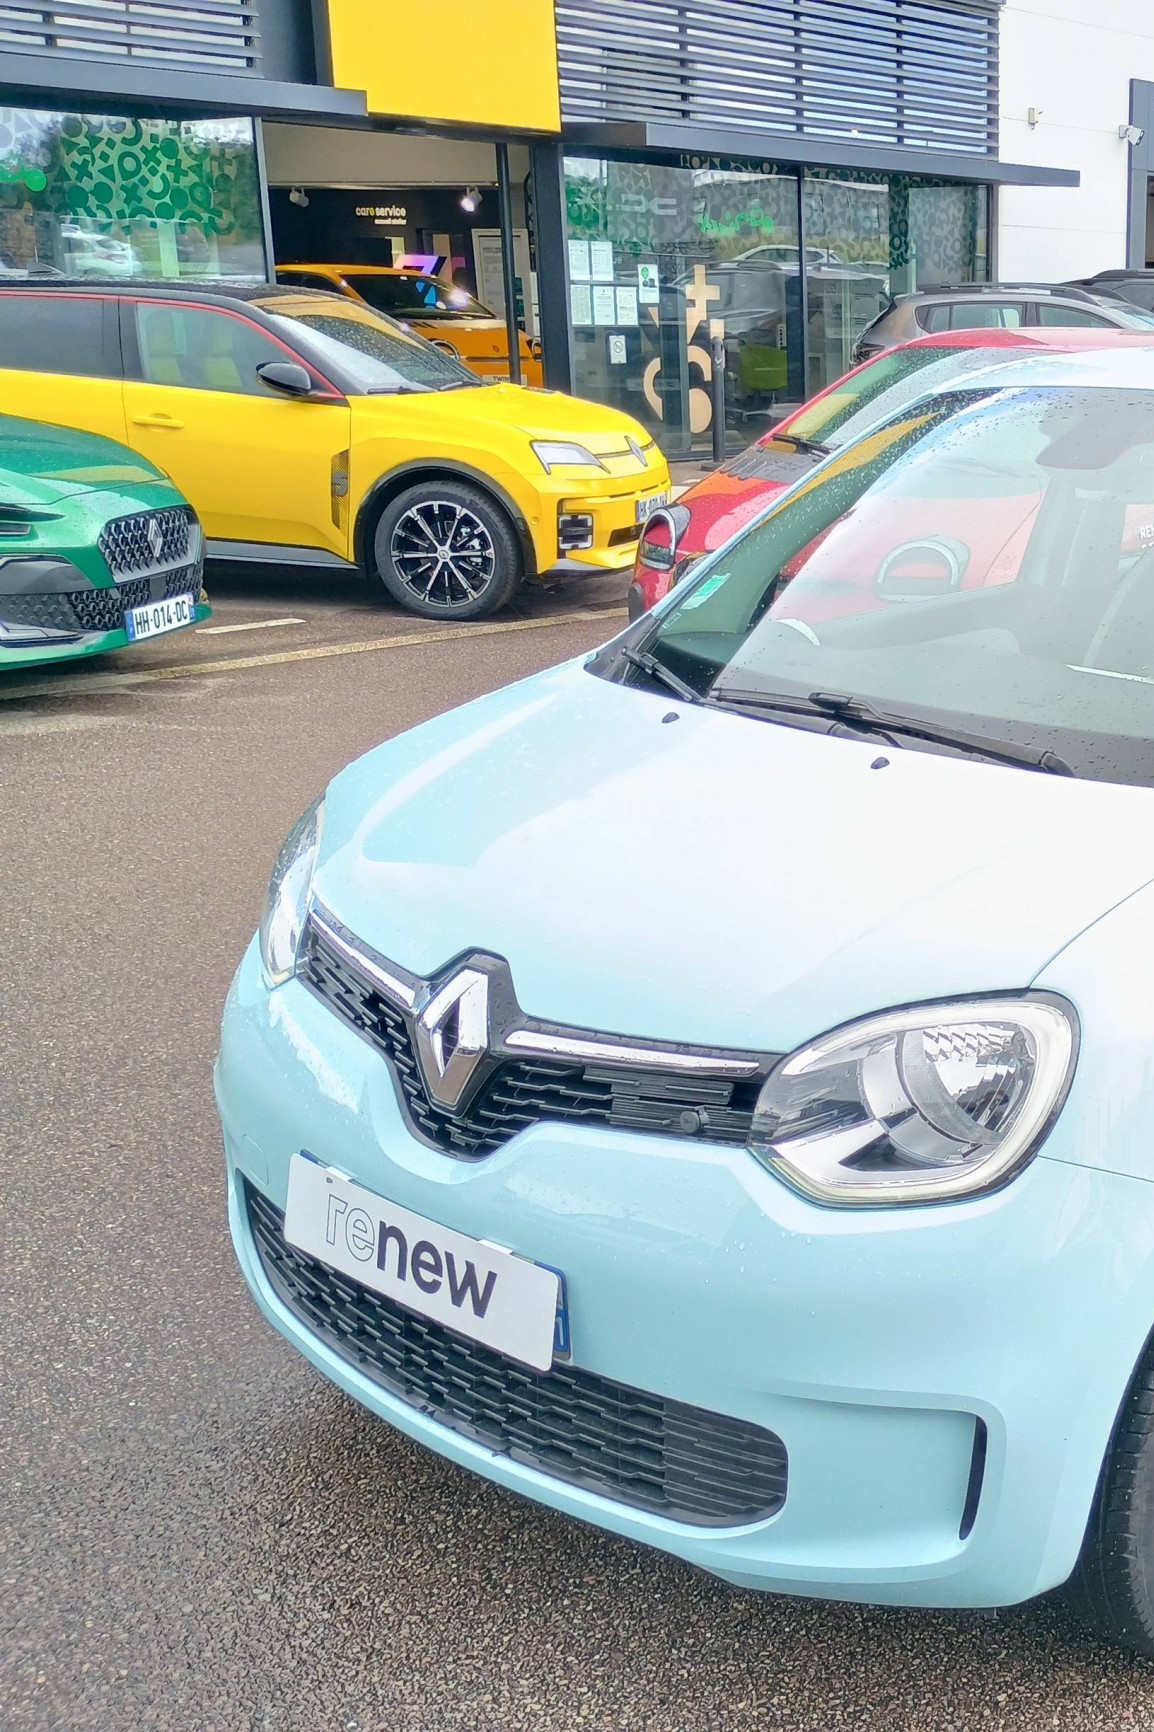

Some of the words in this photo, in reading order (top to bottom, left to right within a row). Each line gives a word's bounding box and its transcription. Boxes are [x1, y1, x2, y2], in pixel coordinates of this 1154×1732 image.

[375, 205, 407, 217] service
[135, 600, 188, 635] HH-014-DC
[325, 1194, 498, 1319] renew
